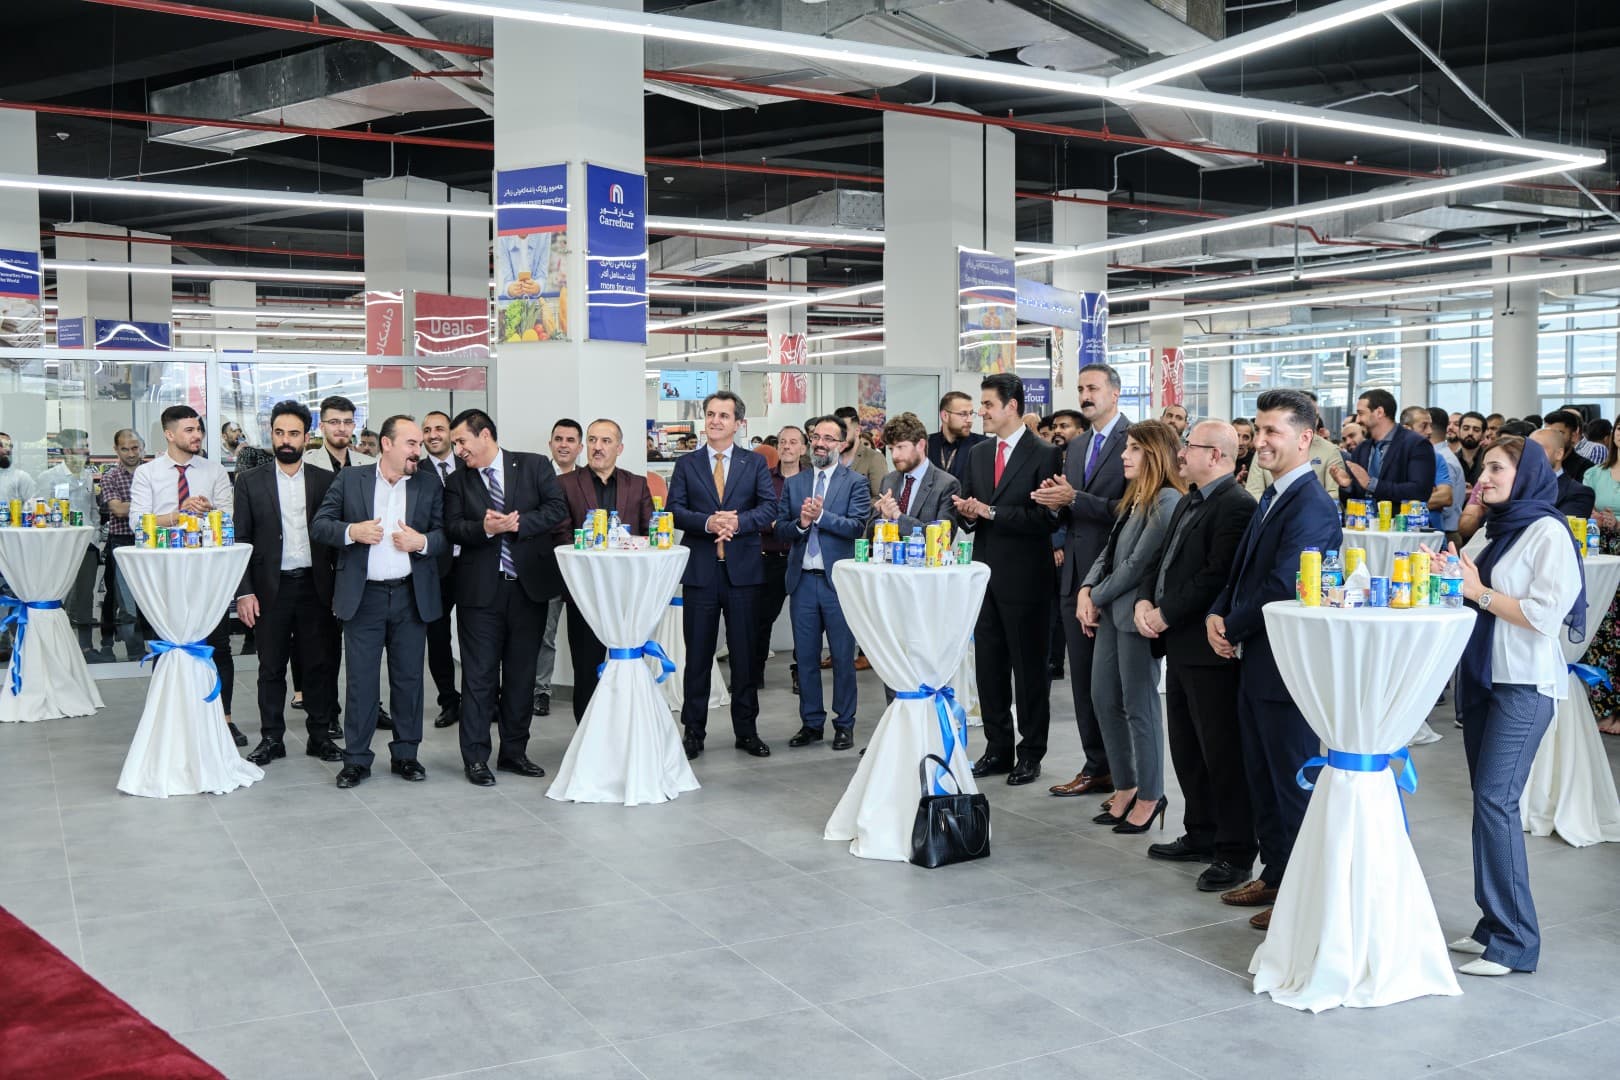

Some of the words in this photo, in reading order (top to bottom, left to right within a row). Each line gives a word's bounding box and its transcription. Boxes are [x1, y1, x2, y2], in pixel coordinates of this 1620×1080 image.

[599, 214, 635, 230] Carrefour
[600, 282, 615, 290] more
[616, 282, 625, 291] for
[430, 318, 475, 337] Deals
